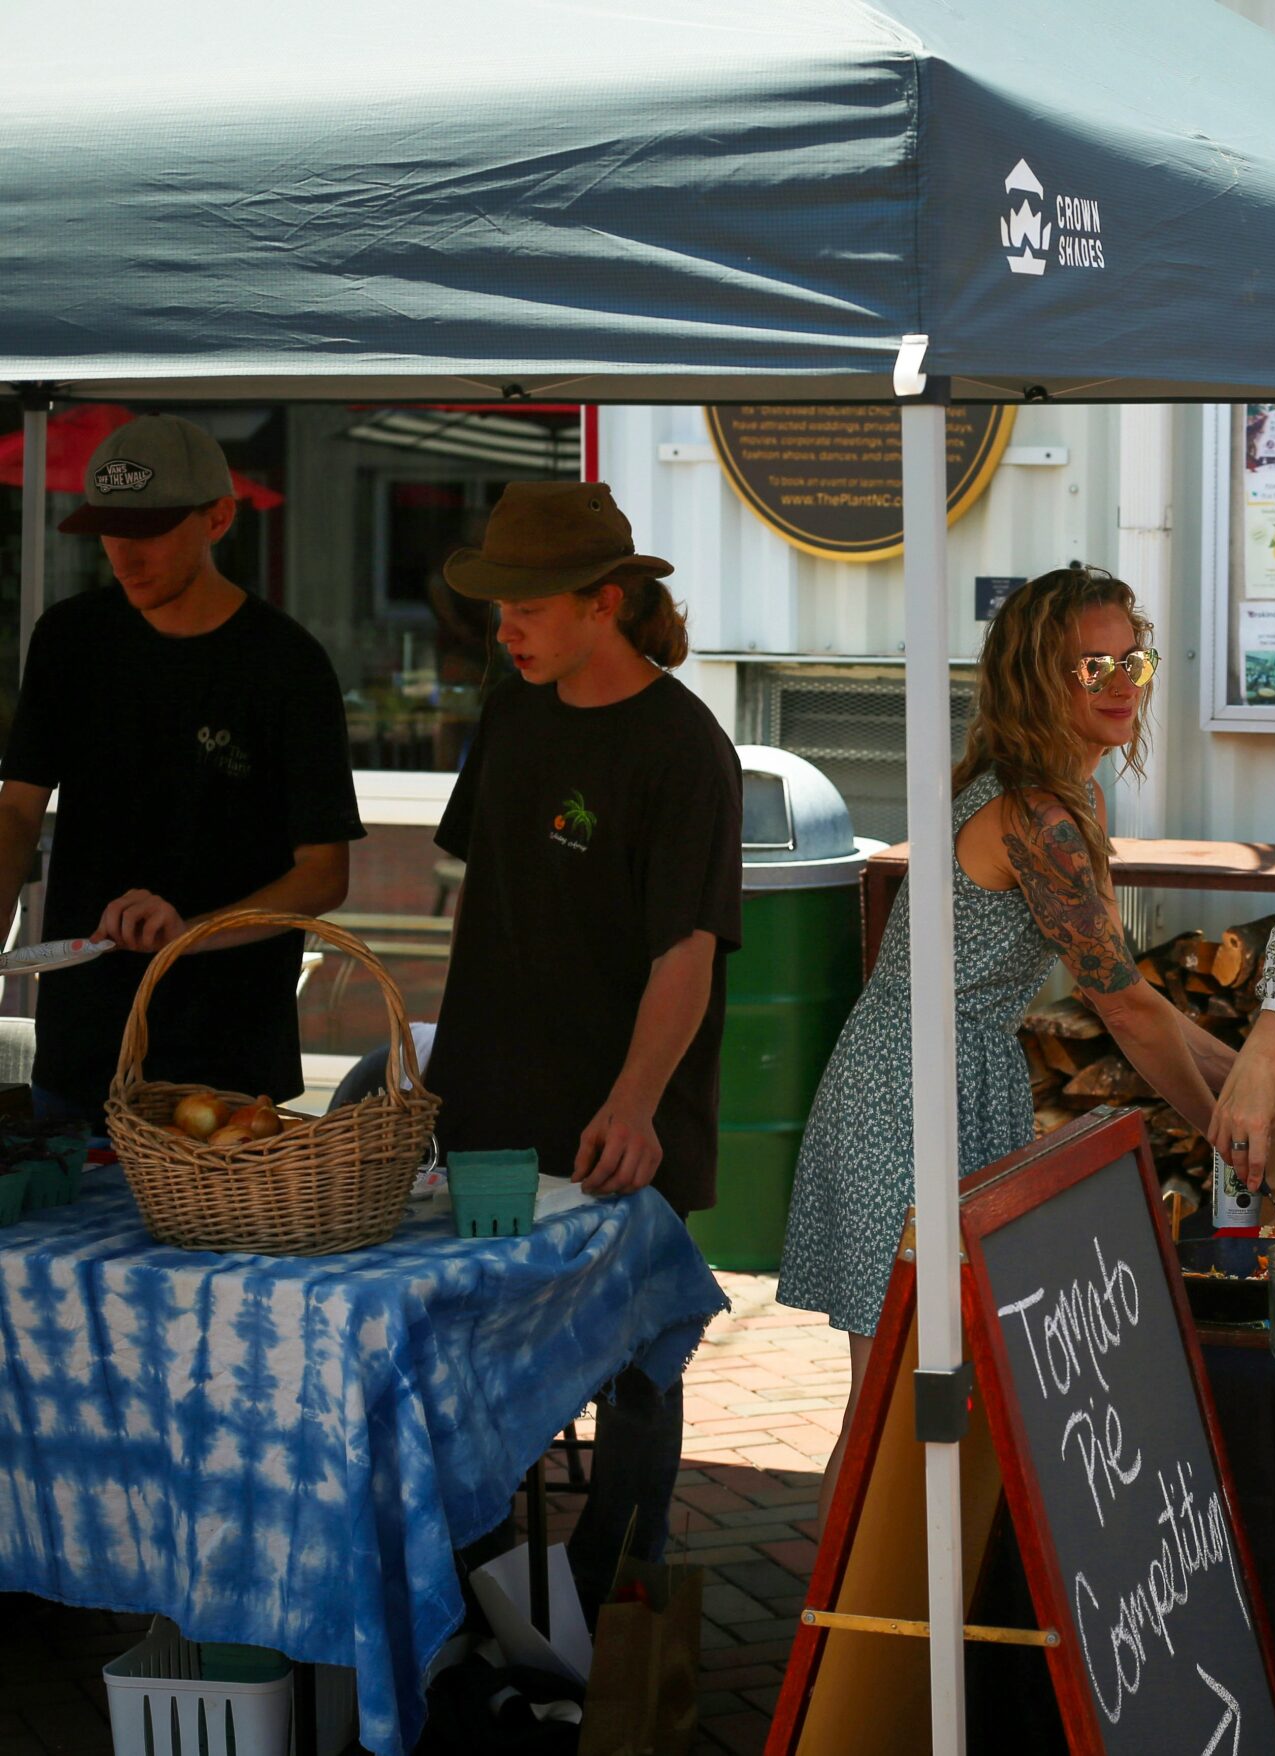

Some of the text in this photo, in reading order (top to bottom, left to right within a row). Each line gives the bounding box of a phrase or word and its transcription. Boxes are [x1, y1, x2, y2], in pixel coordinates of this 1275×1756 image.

[1055, 194, 1101, 233] CROWN
[1058, 235, 1105, 269] SHADES
[106, 463, 128, 475] VANS
[109, 473, 124, 485] THE
[781, 492, 903, 507] www.ThePlantNC.c
[998, 1236, 1140, 1399] Tomato
[1061, 1397, 1142, 1528] Pie
